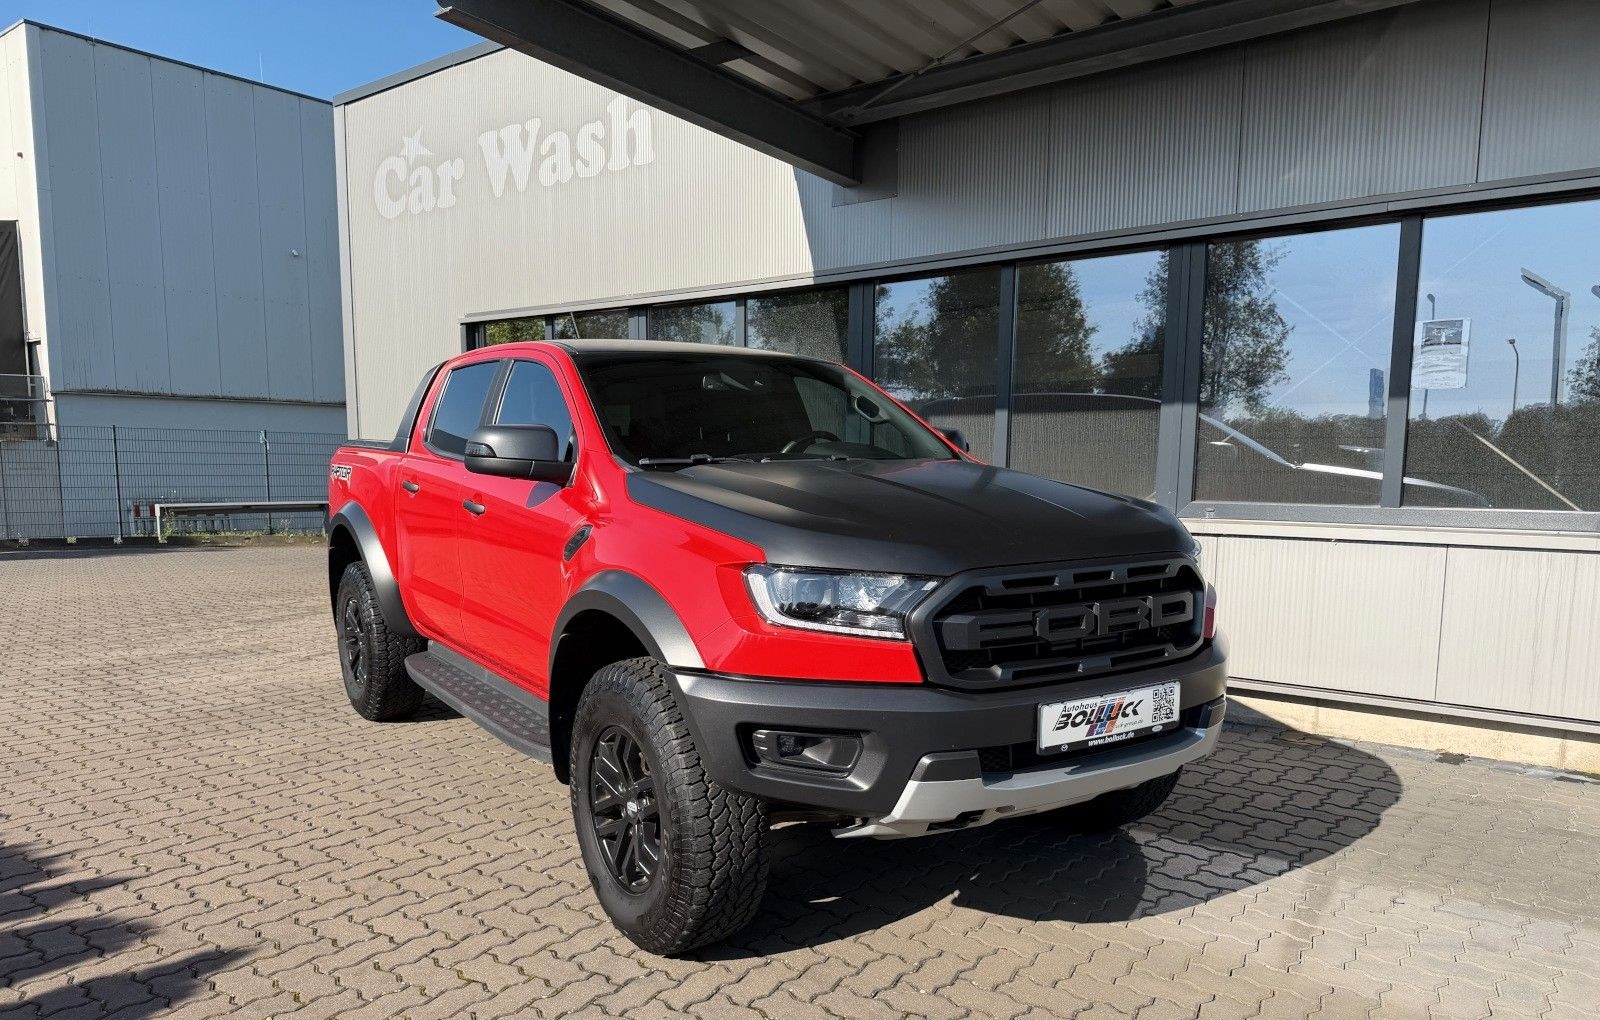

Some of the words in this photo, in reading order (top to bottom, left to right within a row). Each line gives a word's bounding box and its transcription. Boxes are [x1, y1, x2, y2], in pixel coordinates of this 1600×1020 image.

[373, 155, 465, 219] Car
[477, 94, 656, 198] Wash
[942, 591, 1194, 650] FORD
[1061, 702, 1098, 713] Autohaus
